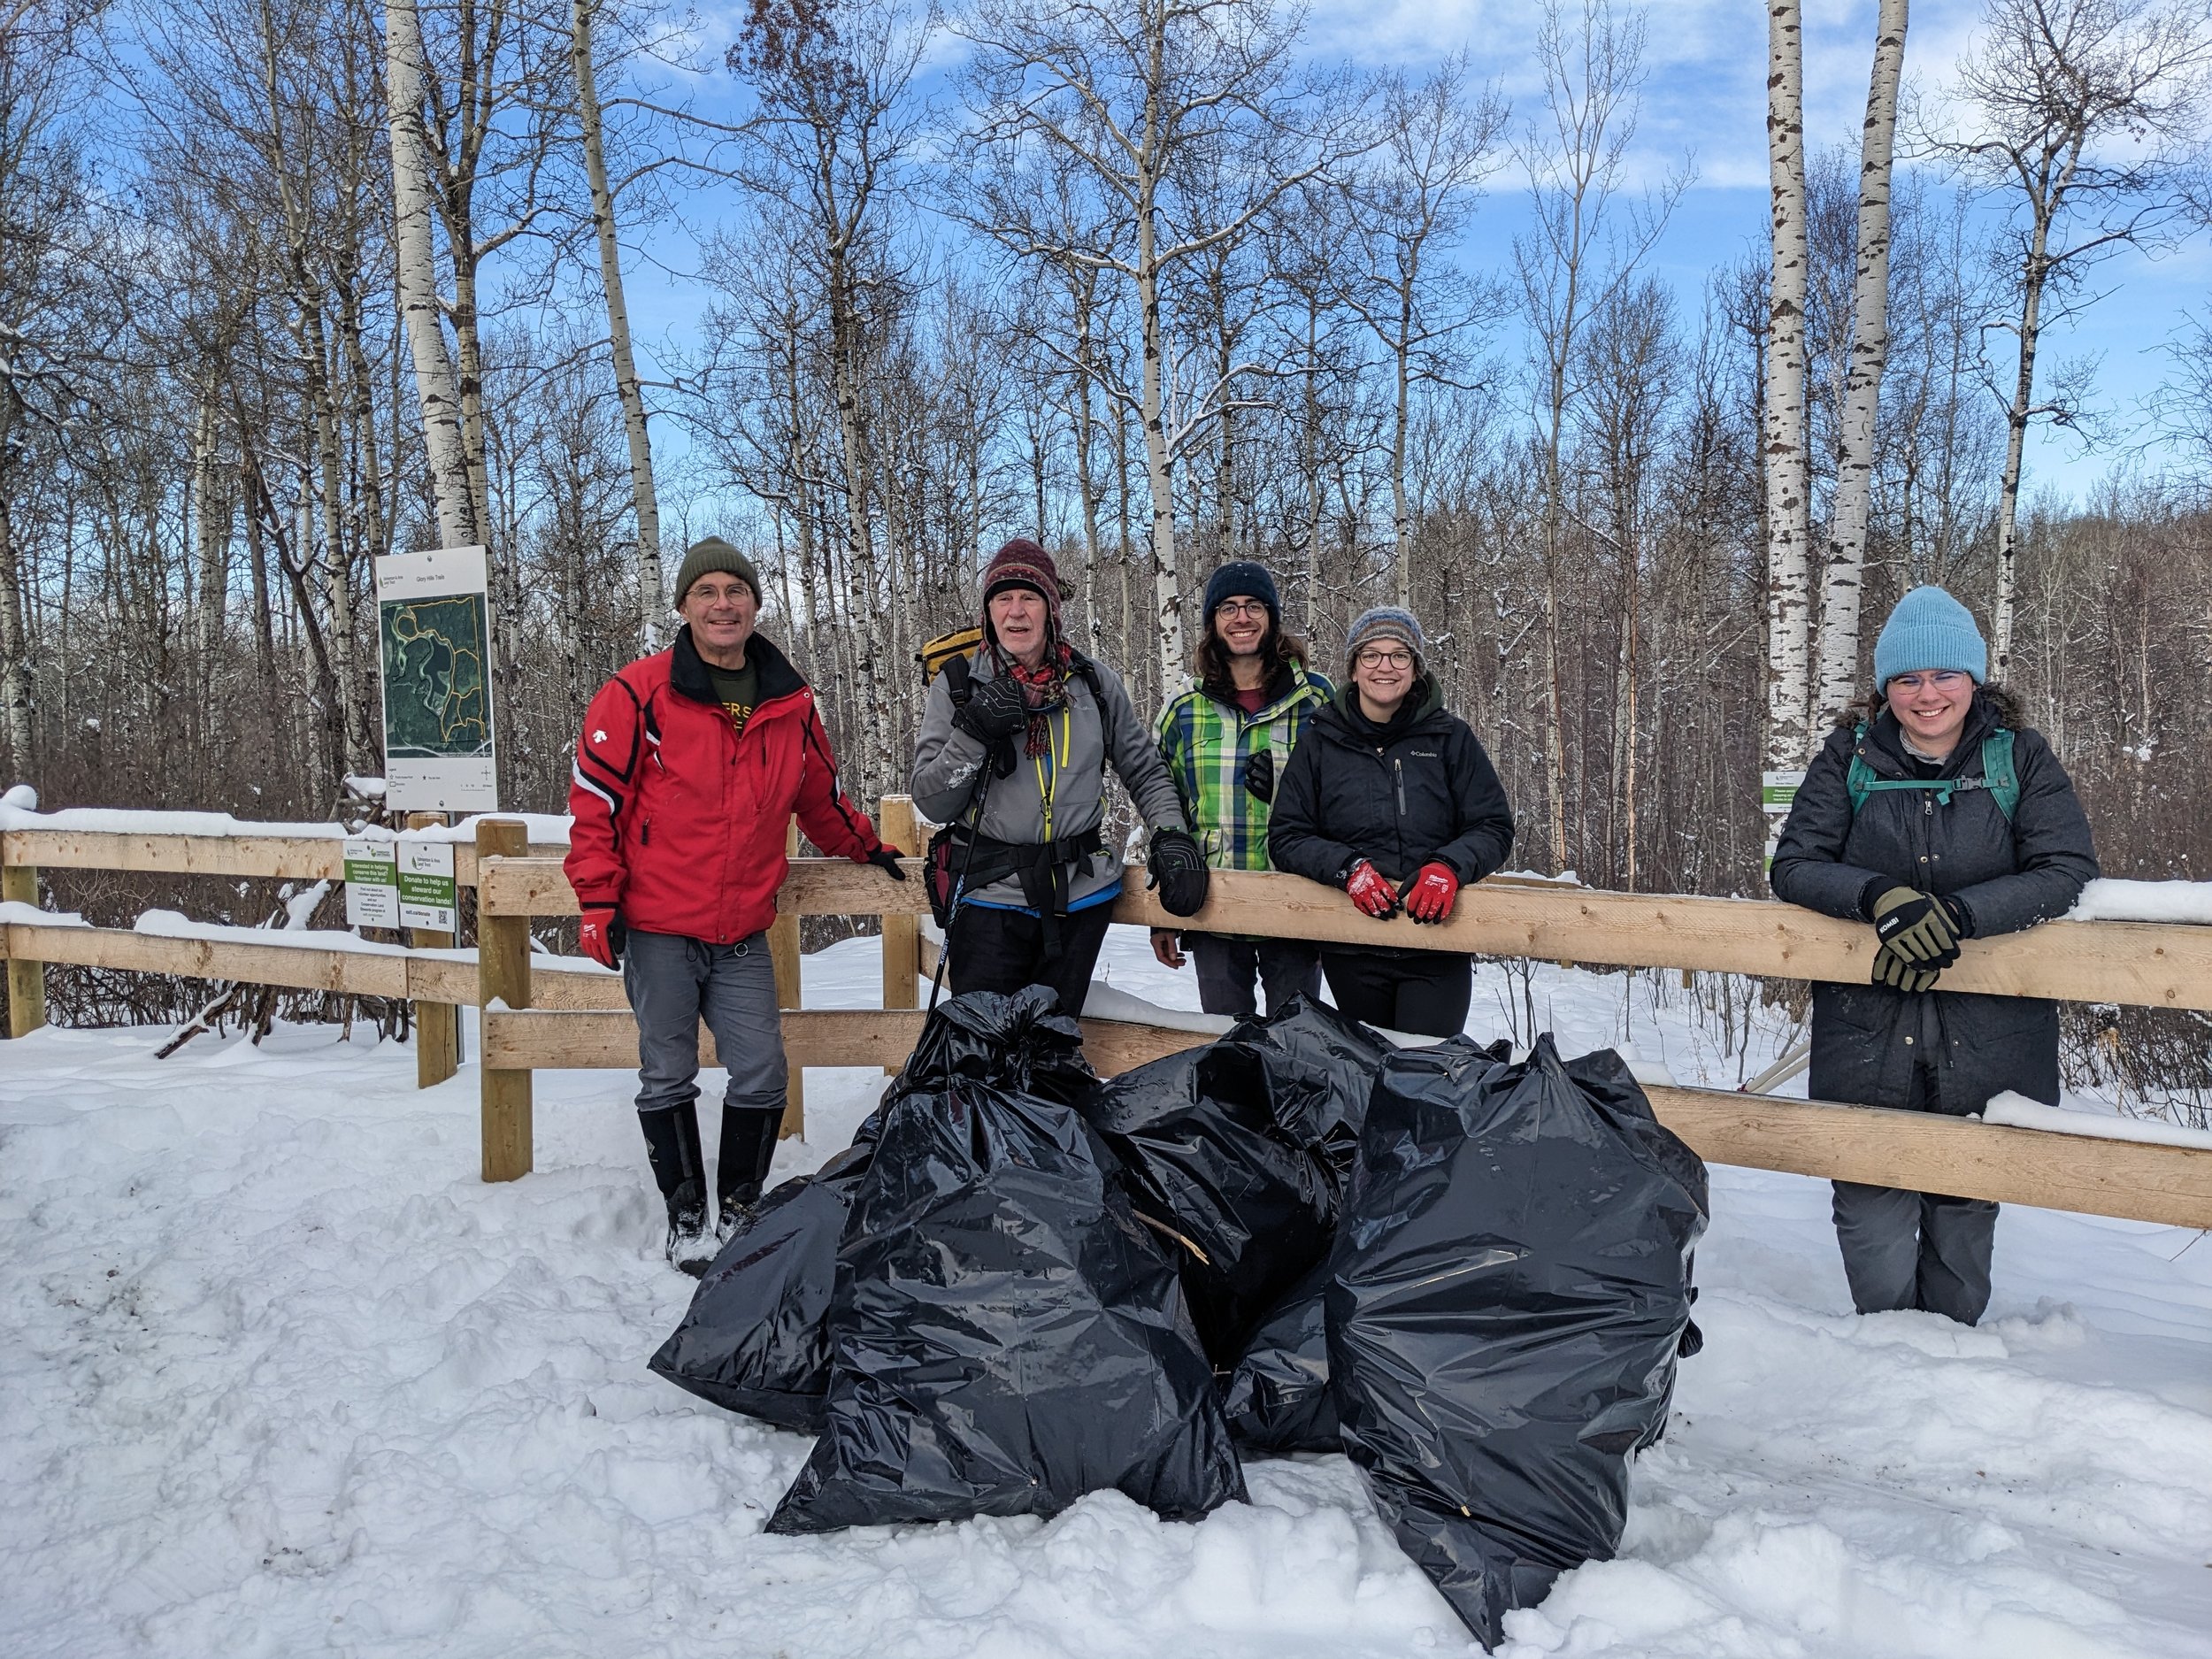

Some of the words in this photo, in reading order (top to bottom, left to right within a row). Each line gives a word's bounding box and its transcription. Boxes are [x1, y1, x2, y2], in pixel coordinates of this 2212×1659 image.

[430, 878, 441, 887] help
[402, 895, 435, 903] conservation
[1879, 917, 1899, 934] KOMBI
